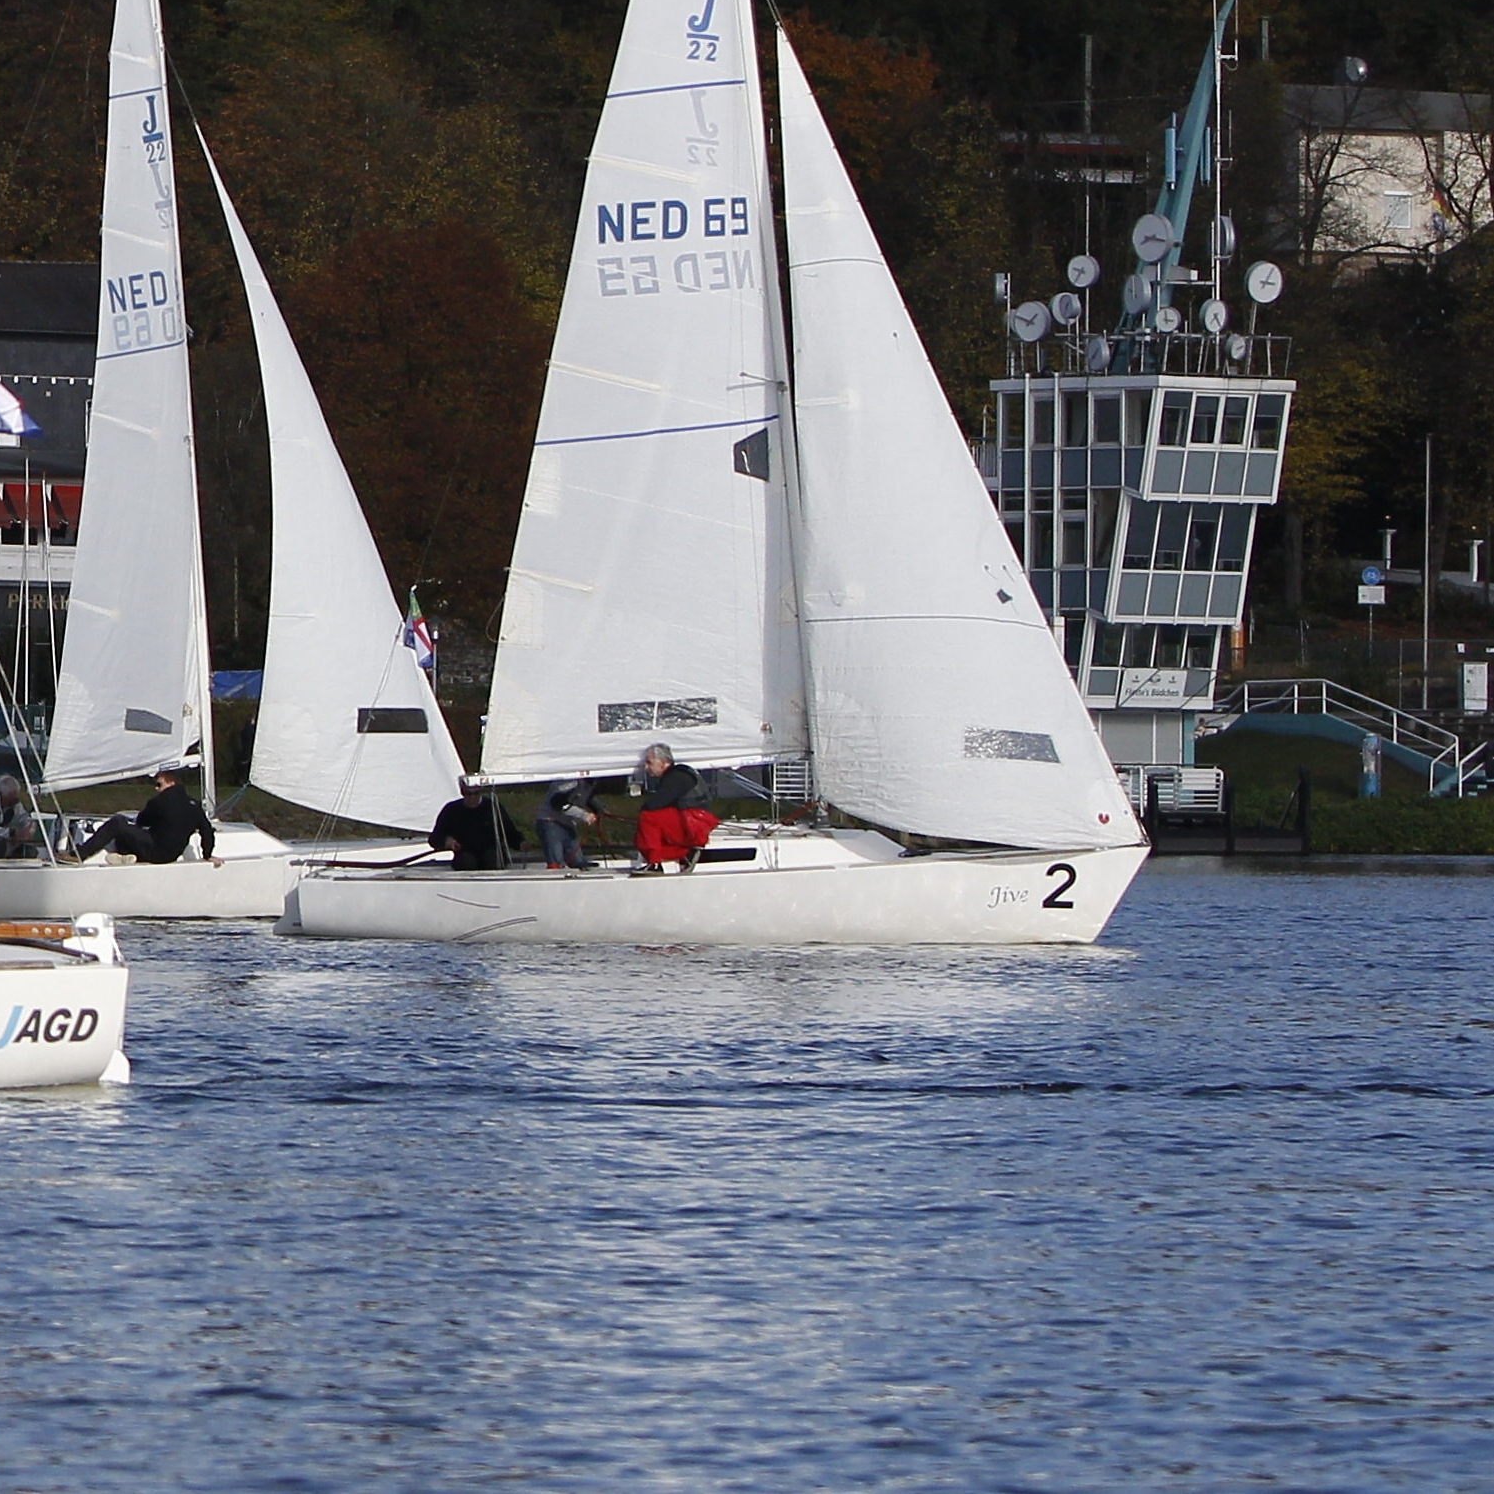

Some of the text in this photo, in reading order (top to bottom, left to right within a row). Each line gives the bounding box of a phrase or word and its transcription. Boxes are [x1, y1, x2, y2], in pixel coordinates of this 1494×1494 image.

[686, 40, 717, 62] 22
[142, 95, 156, 134] J
[145, 141, 167, 164] 22
[597, 197, 749, 244] NED 69
[107, 271, 168, 314] NED
[987, 863, 1077, 909] Jive 2
